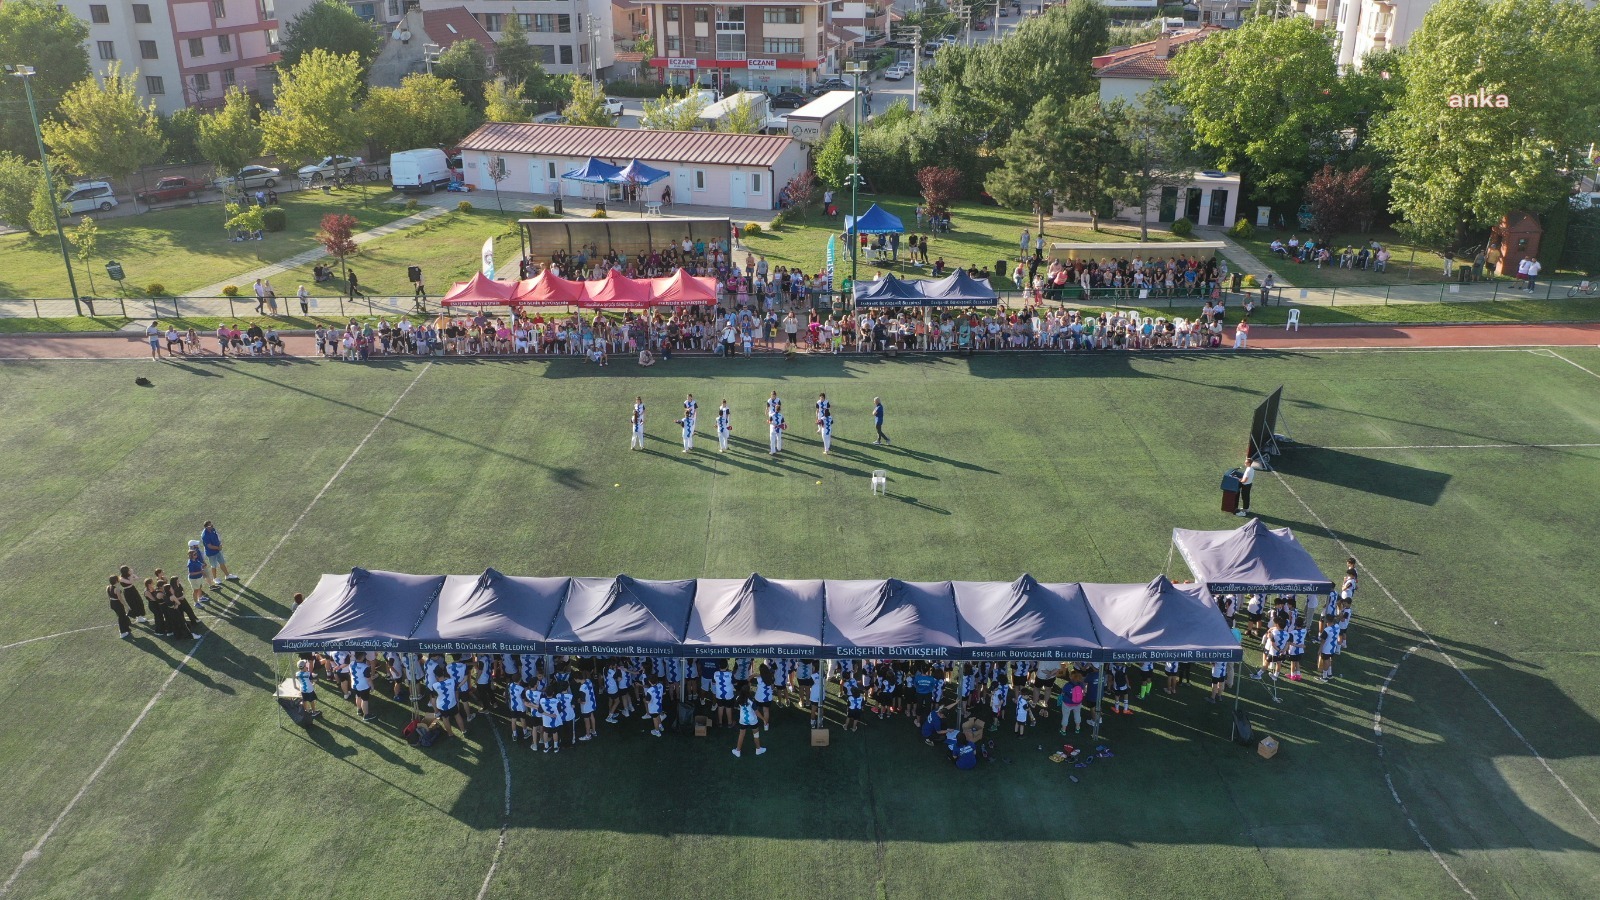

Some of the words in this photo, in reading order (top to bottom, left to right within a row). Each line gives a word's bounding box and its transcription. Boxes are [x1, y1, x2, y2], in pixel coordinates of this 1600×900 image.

[418, 642, 453, 651] ESKİŞEHİR
[455, 642, 498, 652] BÜYÜKŞEHİR
[500, 642, 536, 651] BELEDİYESİ
[555, 645, 590, 654] ESKİŞEHİR
[592, 645, 635, 655] BÜYÜKŞEHİR
[695, 647, 730, 656] ESKİŞEHİR
[732, 646, 775, 656] BÜYÜKŞEHİR
[777, 647, 815, 656] BELEDİYESİ
[837, 646, 884, 657] ESKİŞEHİR
[889, 646, 948, 657] BÜYÜKŞEHİR
[972, 650, 1007, 659] ESKİŞEHİR
[1009, 650, 1052, 659] BÜYÜKŞEHİR
[1055, 650, 1092, 659] BELEDİYESİ
[1150, 650, 1193, 660] BÜYÜKŞEHİR
[1195, 650, 1233, 659] BELEDİYESİ
